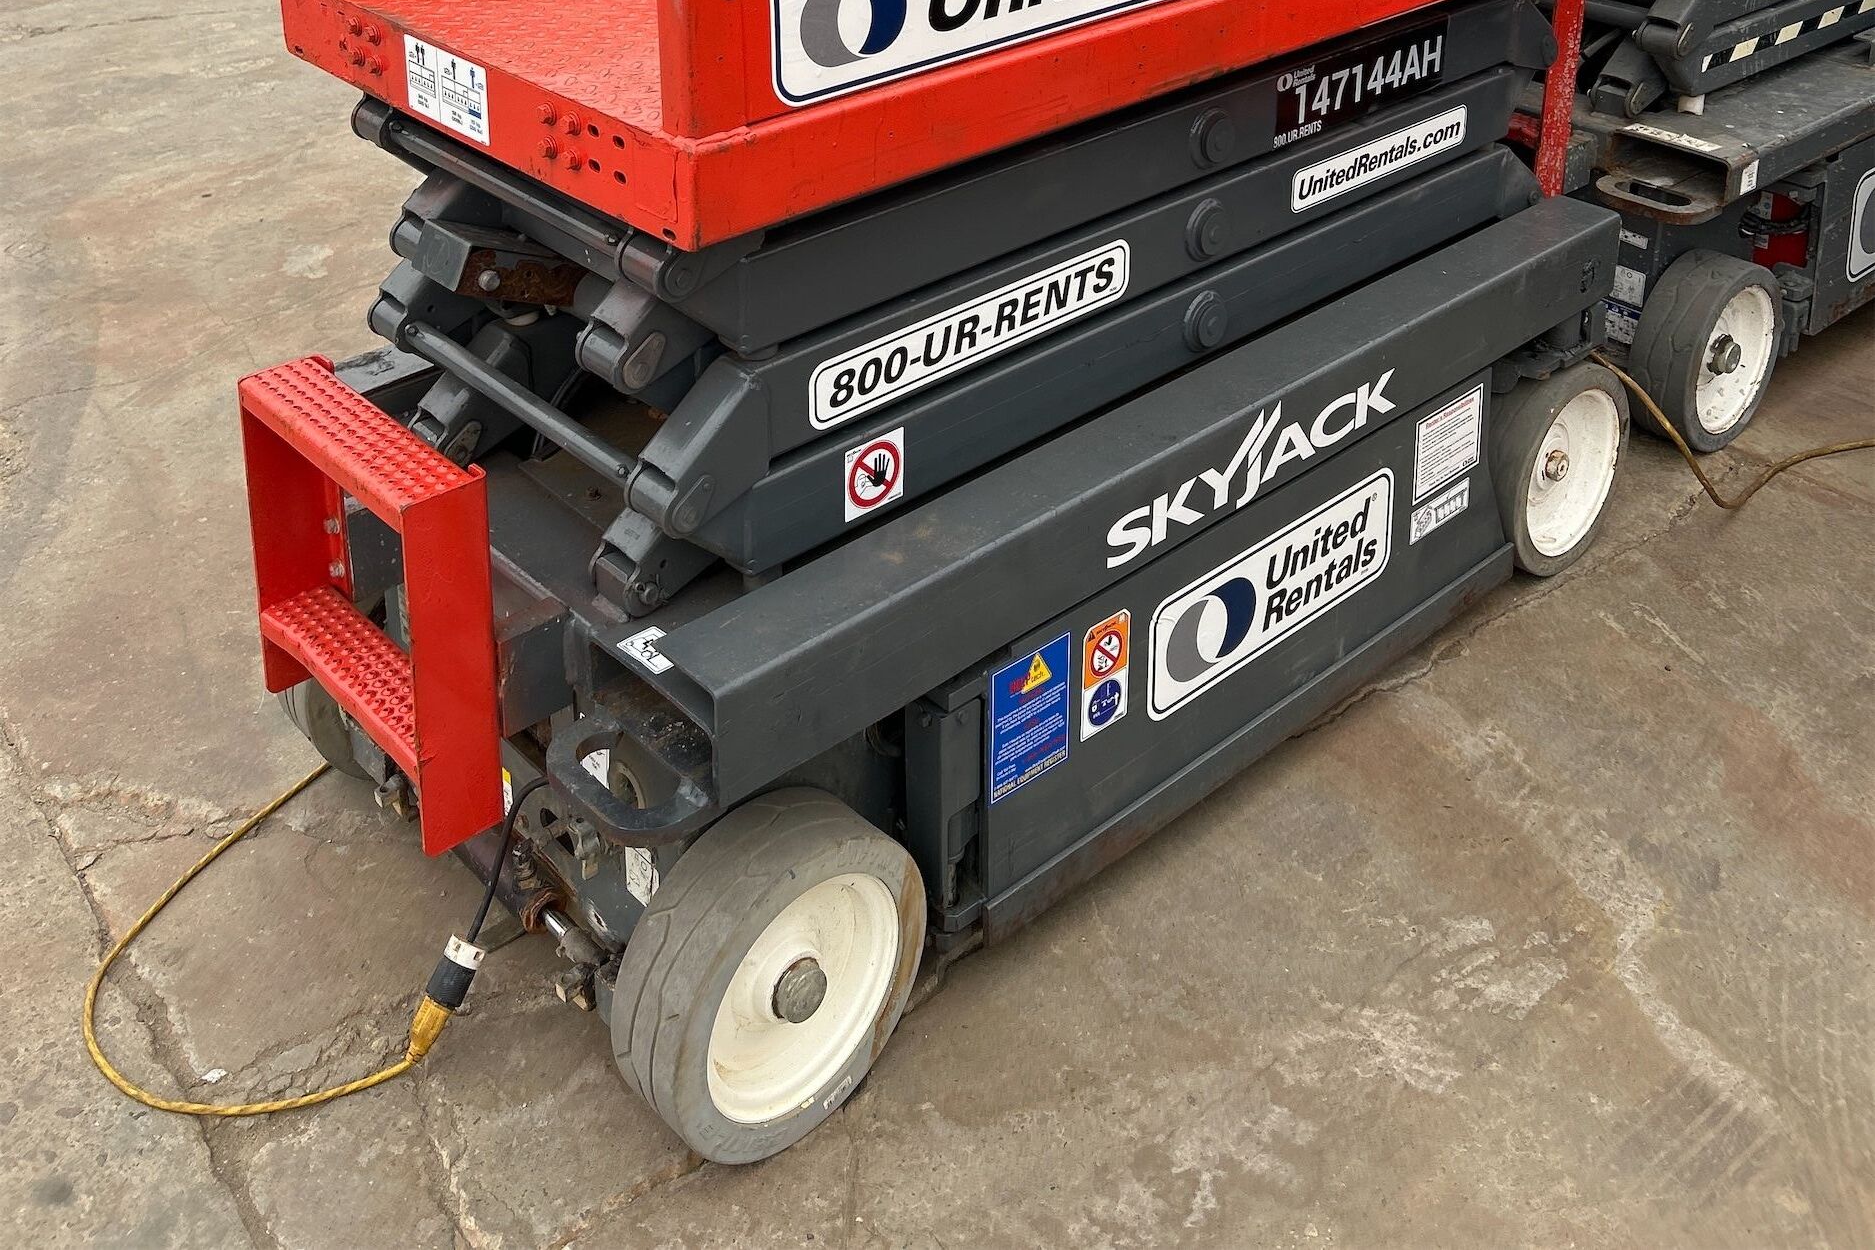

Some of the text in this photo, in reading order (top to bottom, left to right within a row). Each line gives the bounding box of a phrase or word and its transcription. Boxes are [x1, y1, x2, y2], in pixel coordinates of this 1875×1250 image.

[1295, 35, 1443, 124] 147144AH
[1298, 121, 1461, 200] UnitedRentals.com
[829, 257, 1116, 408] 800-UR-RENTS
[1106, 368, 1396, 569] SKYJACK
[1262, 536, 1377, 633] Rentals
[1265, 496, 1371, 589] United
[994, 779, 1017, 798] NATIONAL
[1017, 762, 1043, 786] EQUIPMENT
